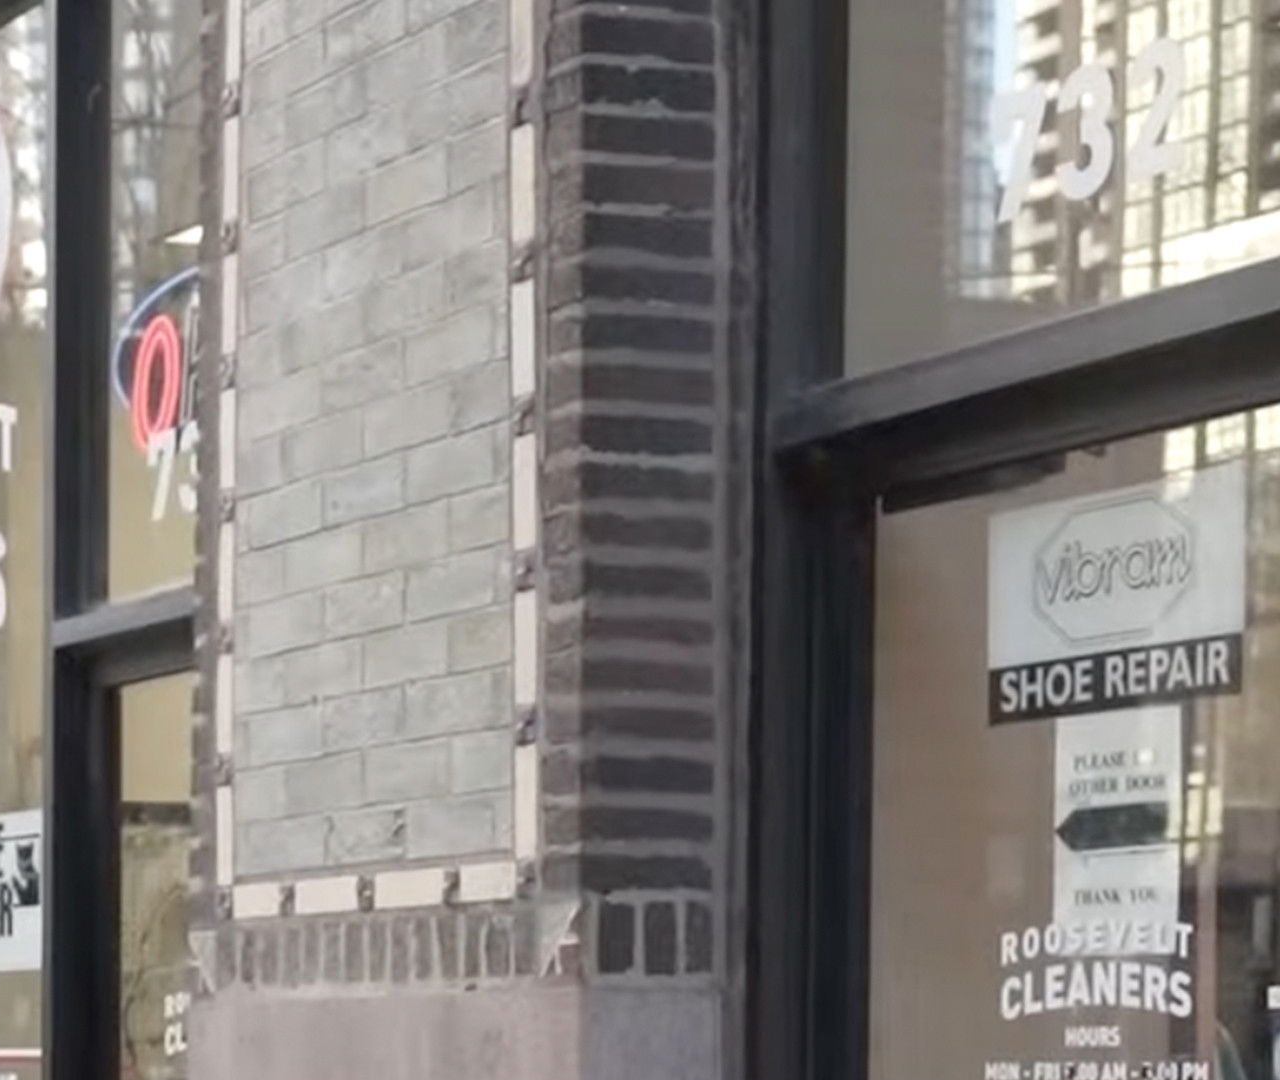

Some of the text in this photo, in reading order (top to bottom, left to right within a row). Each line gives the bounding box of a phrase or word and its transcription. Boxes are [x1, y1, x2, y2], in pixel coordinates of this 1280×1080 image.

[990, 37, 1186, 223] 732
[1037, 533, 1192, 606] vibram
[999, 639, 1230, 714] SHOE REPAIR
[1073, 885, 1157, 906] THANK YOU
[1000, 918, 1193, 968] ROOSEVELT
[1000, 960, 1193, 1021] CLEANERS
[1064, 1026, 1122, 1047] HOURS
